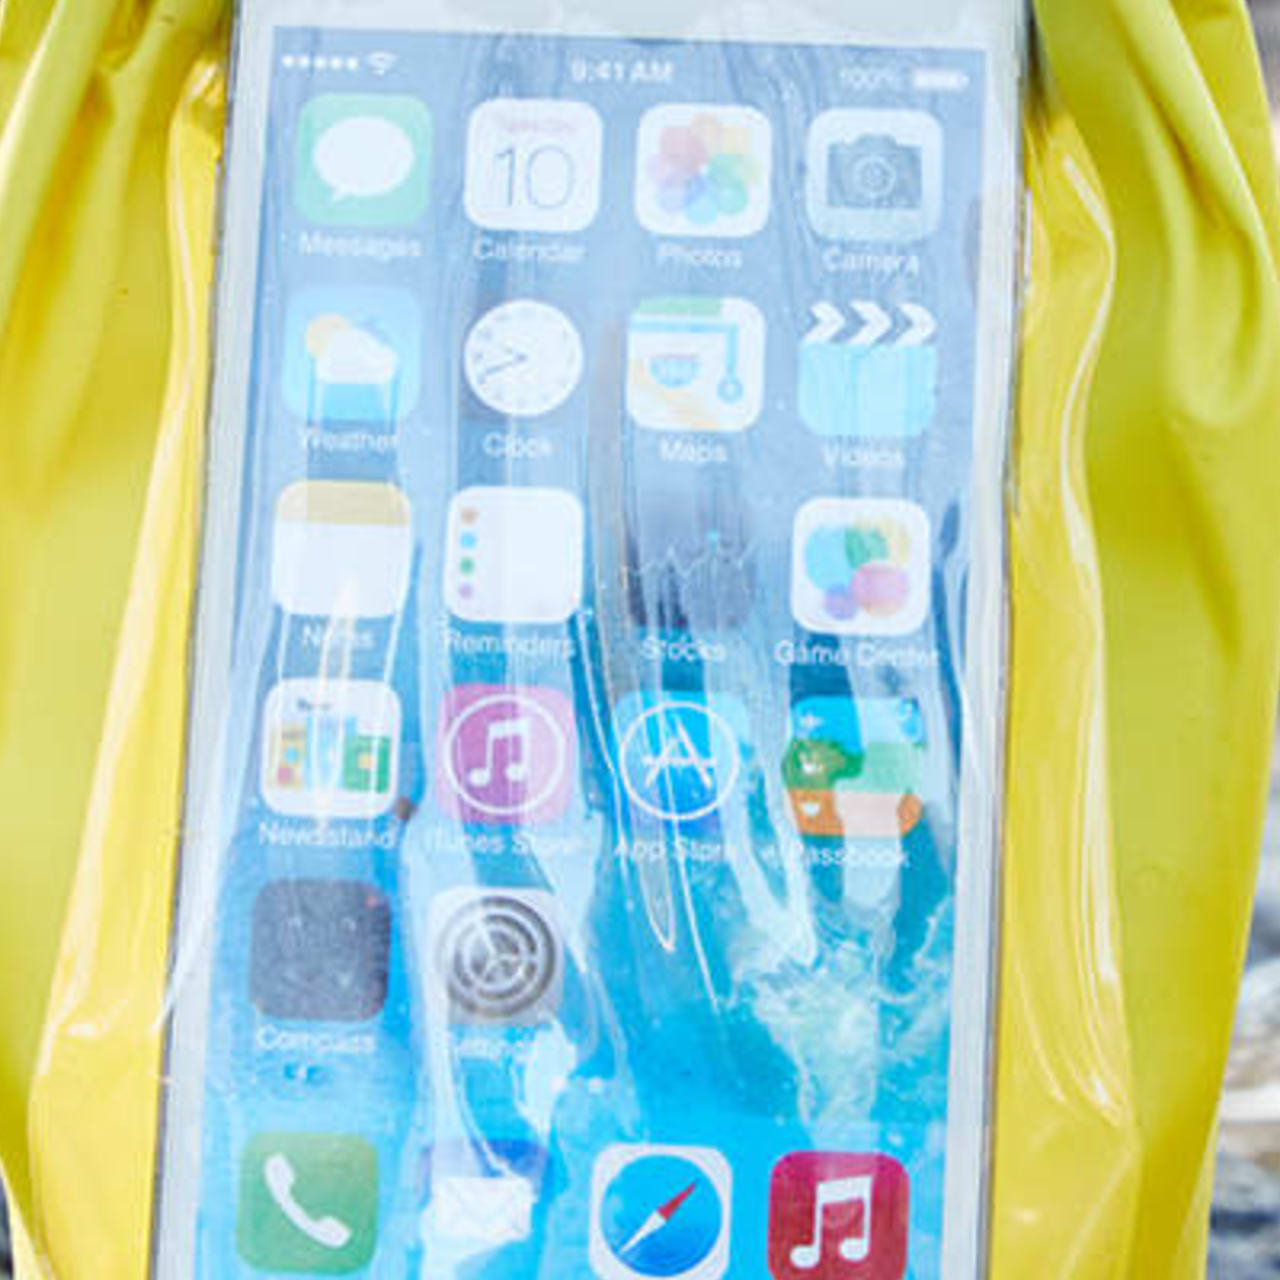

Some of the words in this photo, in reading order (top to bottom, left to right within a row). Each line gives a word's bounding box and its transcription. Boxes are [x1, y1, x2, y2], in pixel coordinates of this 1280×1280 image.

[630, 61, 675, 83] AM
[497, 145, 574, 209] 10
[300, 233, 421, 261] Messages
[474, 238, 586, 262] Calendar
[659, 245, 743, 267] Photos
[823, 249, 920, 274] Camera
[483, 432, 553, 458] Clock
[660, 440, 728, 465] Maps
[823, 445, 905, 469] Videos
[774, 641, 849, 666] Game
[259, 824, 398, 849] Newsstand
[257, 1025, 374, 1053] Compass
